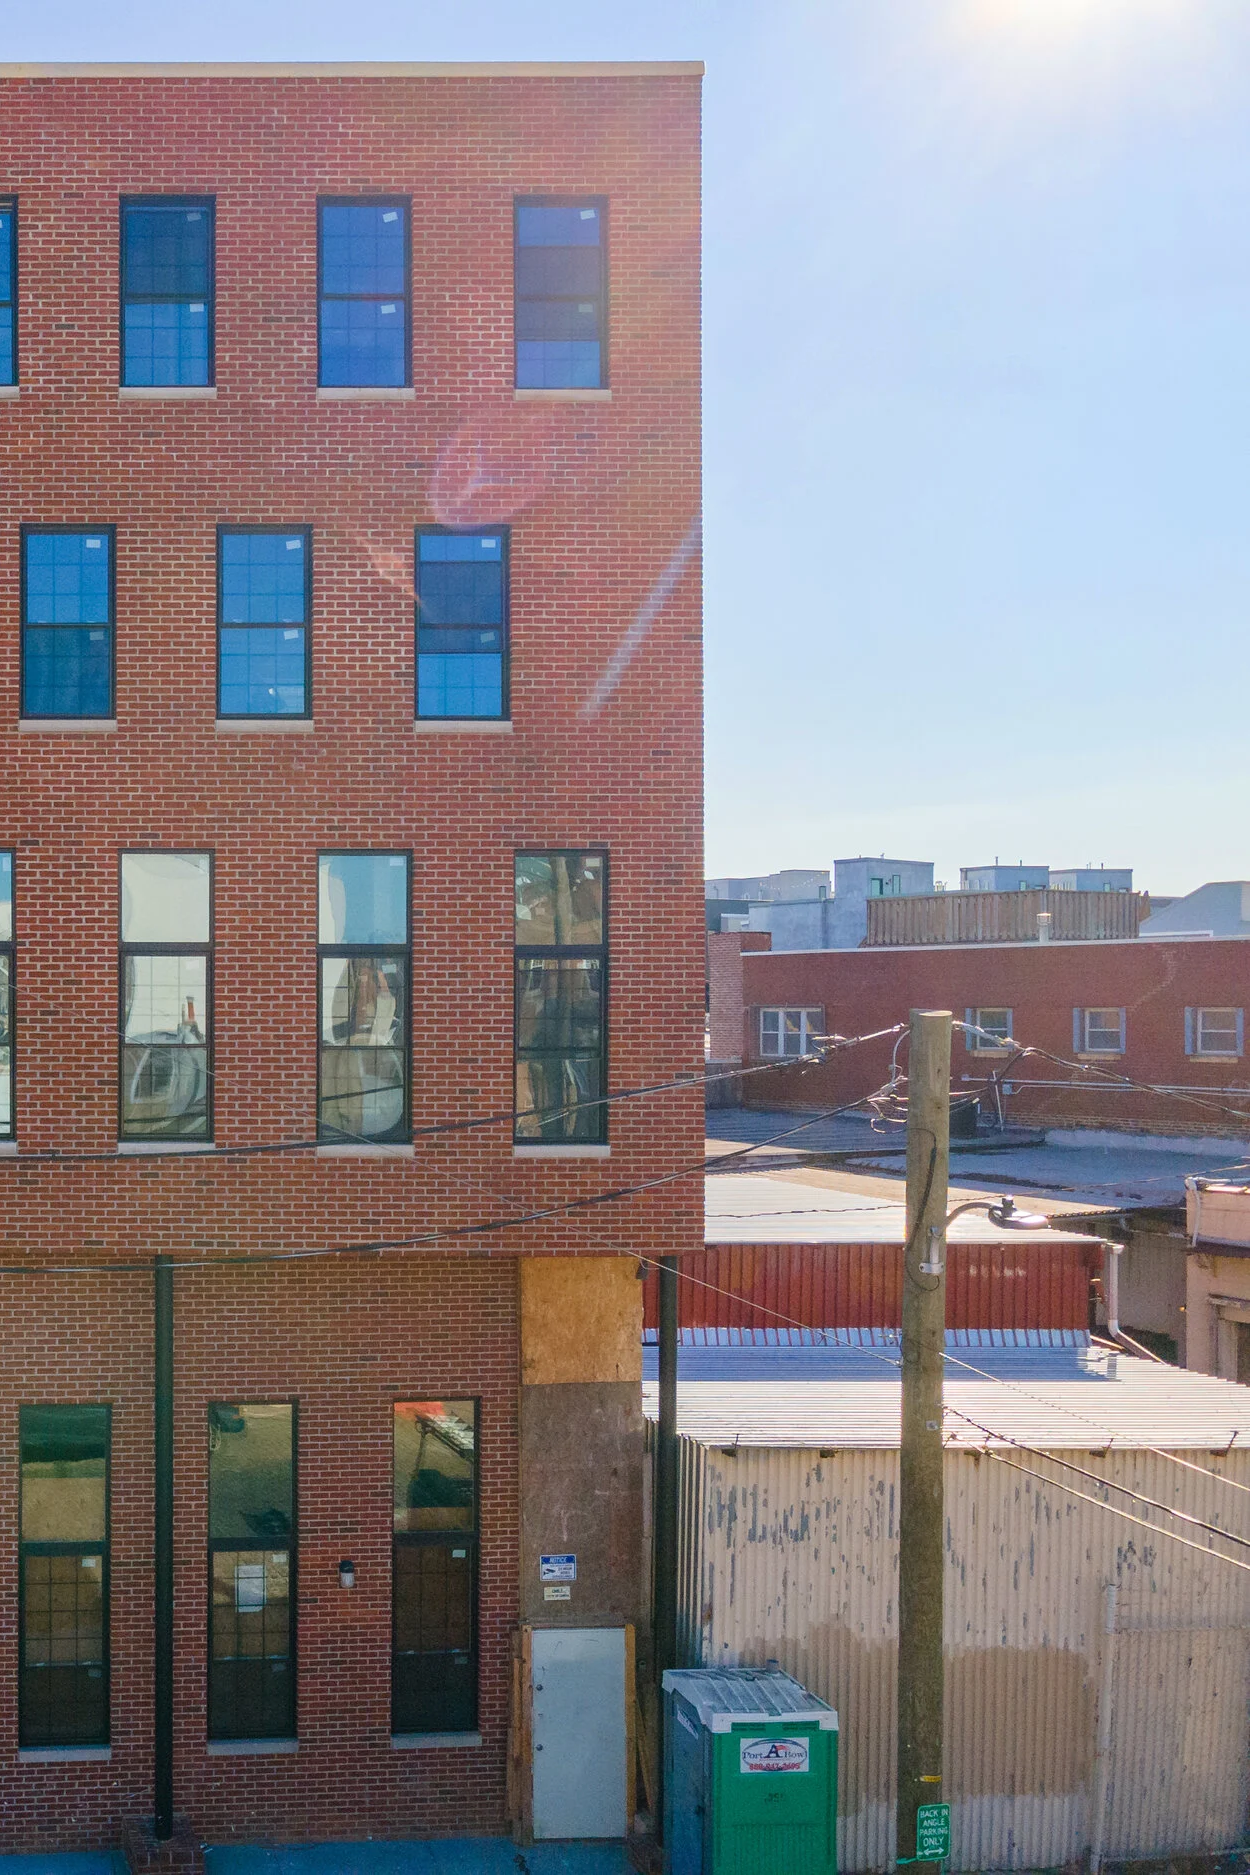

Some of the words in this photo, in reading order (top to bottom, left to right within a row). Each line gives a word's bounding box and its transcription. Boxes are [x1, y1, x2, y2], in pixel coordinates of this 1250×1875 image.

[764, 1744, 783, 1759] A
[920, 1809, 938, 1818] BACK
[941, 1808, 948, 1816] IN
[922, 1818, 945, 1827] ANGLE
[919, 1826, 948, 1836] PARKING
[922, 1837, 944, 1847] ONLY
